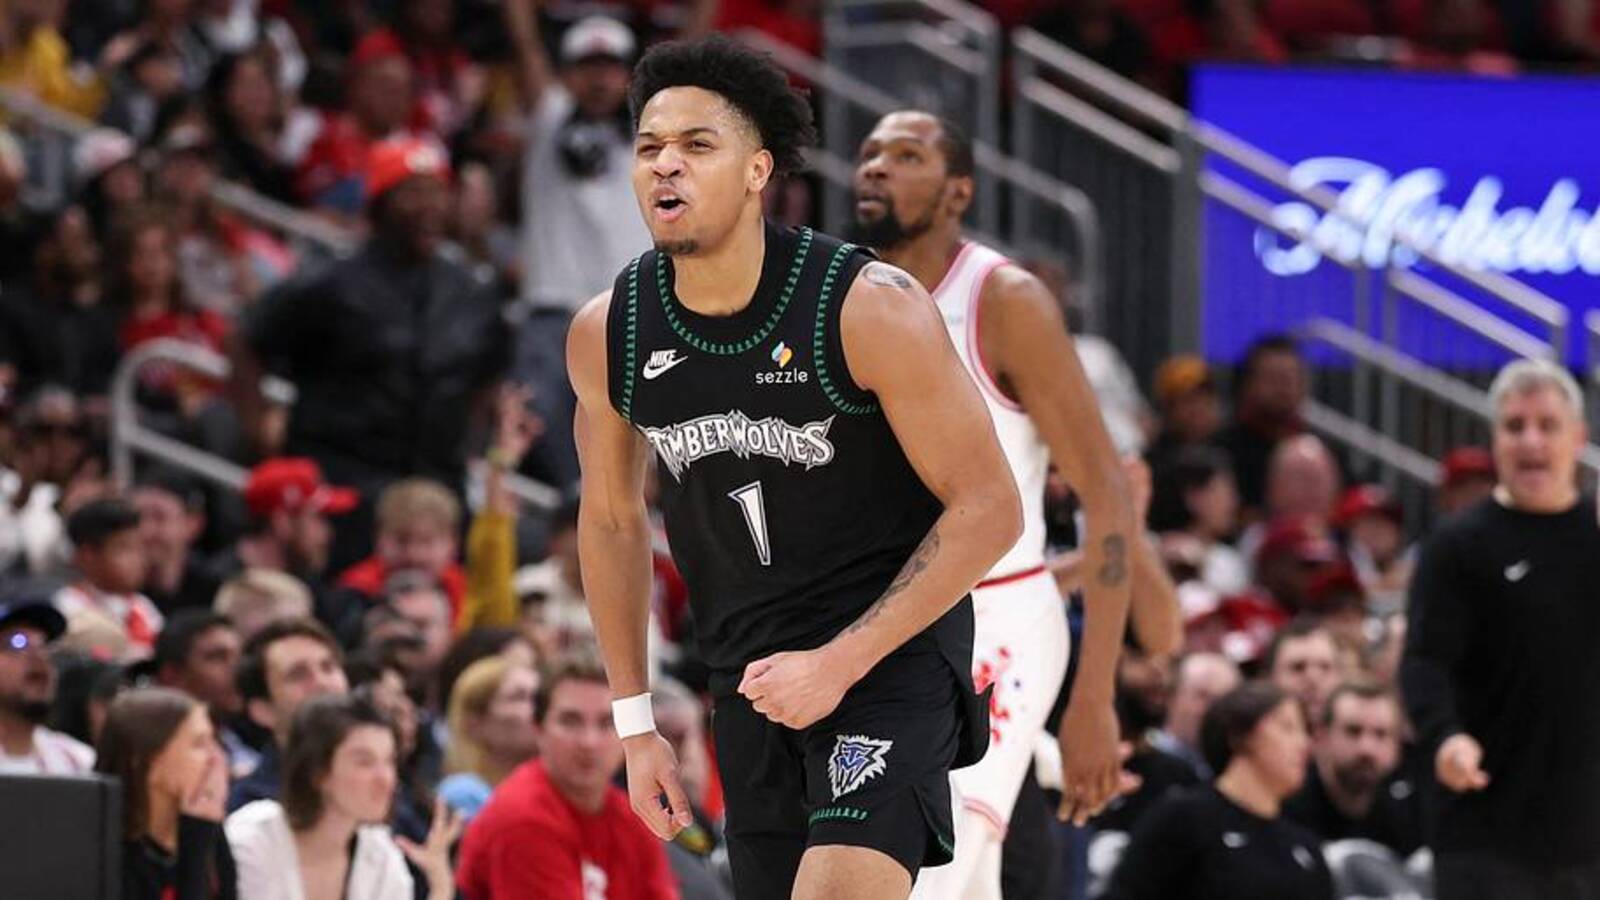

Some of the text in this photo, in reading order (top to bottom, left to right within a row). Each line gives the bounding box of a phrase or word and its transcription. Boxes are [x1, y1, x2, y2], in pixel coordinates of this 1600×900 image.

[1254, 157, 1600, 275] Michelo
[649, 350, 678, 367] NIKE
[755, 368, 808, 384] sezzle
[635, 409, 836, 484] TIMBERWOLVES
[728, 481, 770, 566] 1
